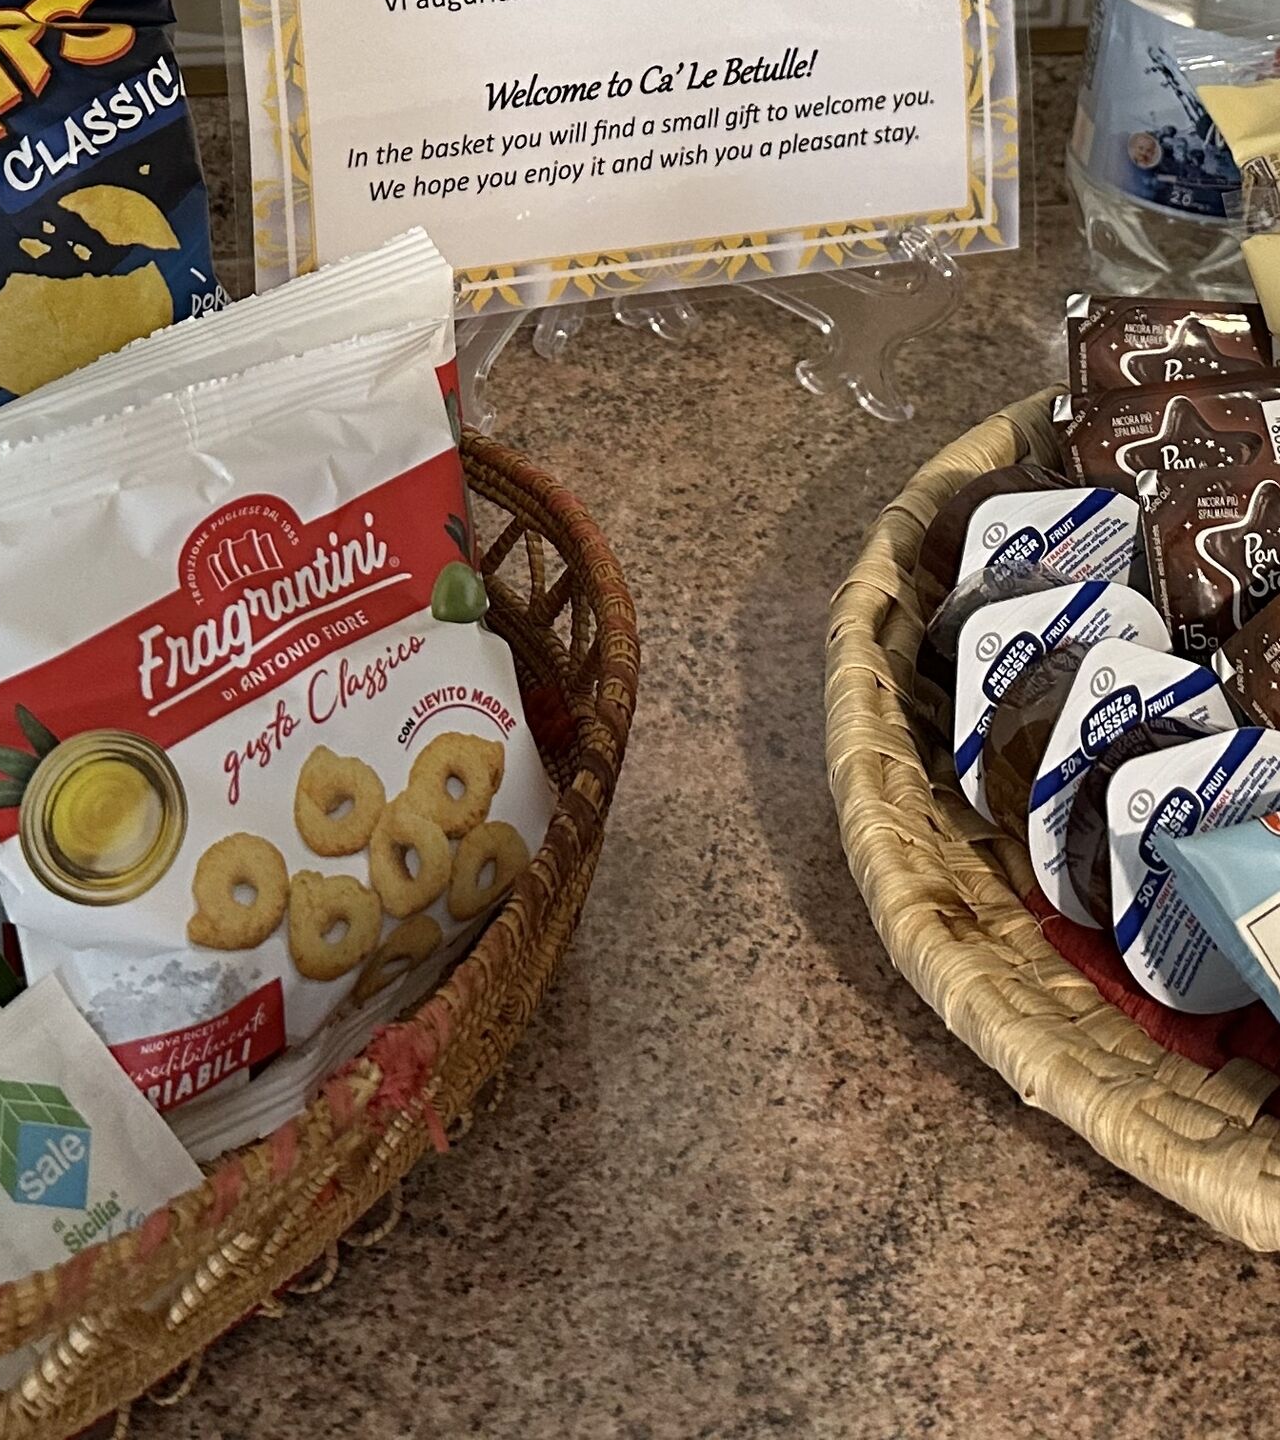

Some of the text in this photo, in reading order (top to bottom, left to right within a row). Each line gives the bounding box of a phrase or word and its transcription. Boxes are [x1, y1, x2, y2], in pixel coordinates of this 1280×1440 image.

[485, 47, 819, 112] Welcome to Ca' Le Betulle!
[2, 57, 186, 192] CLASSIC
[347, 89, 935, 168] In the basket you will find a small gift to welcome you.
[370, 124, 920, 201] We hope you enjoy it and wish you a pleasant stay.
[1161, 445, 1196, 470] Pan
[1048, 516, 1076, 544] FRUIT
[1197, 496, 1225, 508] ANCORA
[186, 504, 300, 607] TRADIZIONE PUGLIESE DAL 1955
[1244, 533, 1280, 568] Pan
[138, 512, 390, 700] Fragrantini
[1044, 613, 1072, 645] FRUIT
[240, 609, 369, 692] ANTONIO FIORE
[987, 638, 1027, 687] MENZ&
[1178, 624, 1218, 651] 15g
[992, 641, 1038, 699] GASSER
[222, 633, 426, 805] gusto Classico
[398, 684, 517, 746] CON LIEVITO MADRE
[1087, 693, 1133, 730] MENZ&
[1087, 703, 1139, 747] GASSER
[1146, 691, 1175, 717] FRUIT
[1202, 766, 1228, 801] FRUIT
[19, 1133, 86, 1201] sale
[63, 1198, 122, 1254] Sicilia
